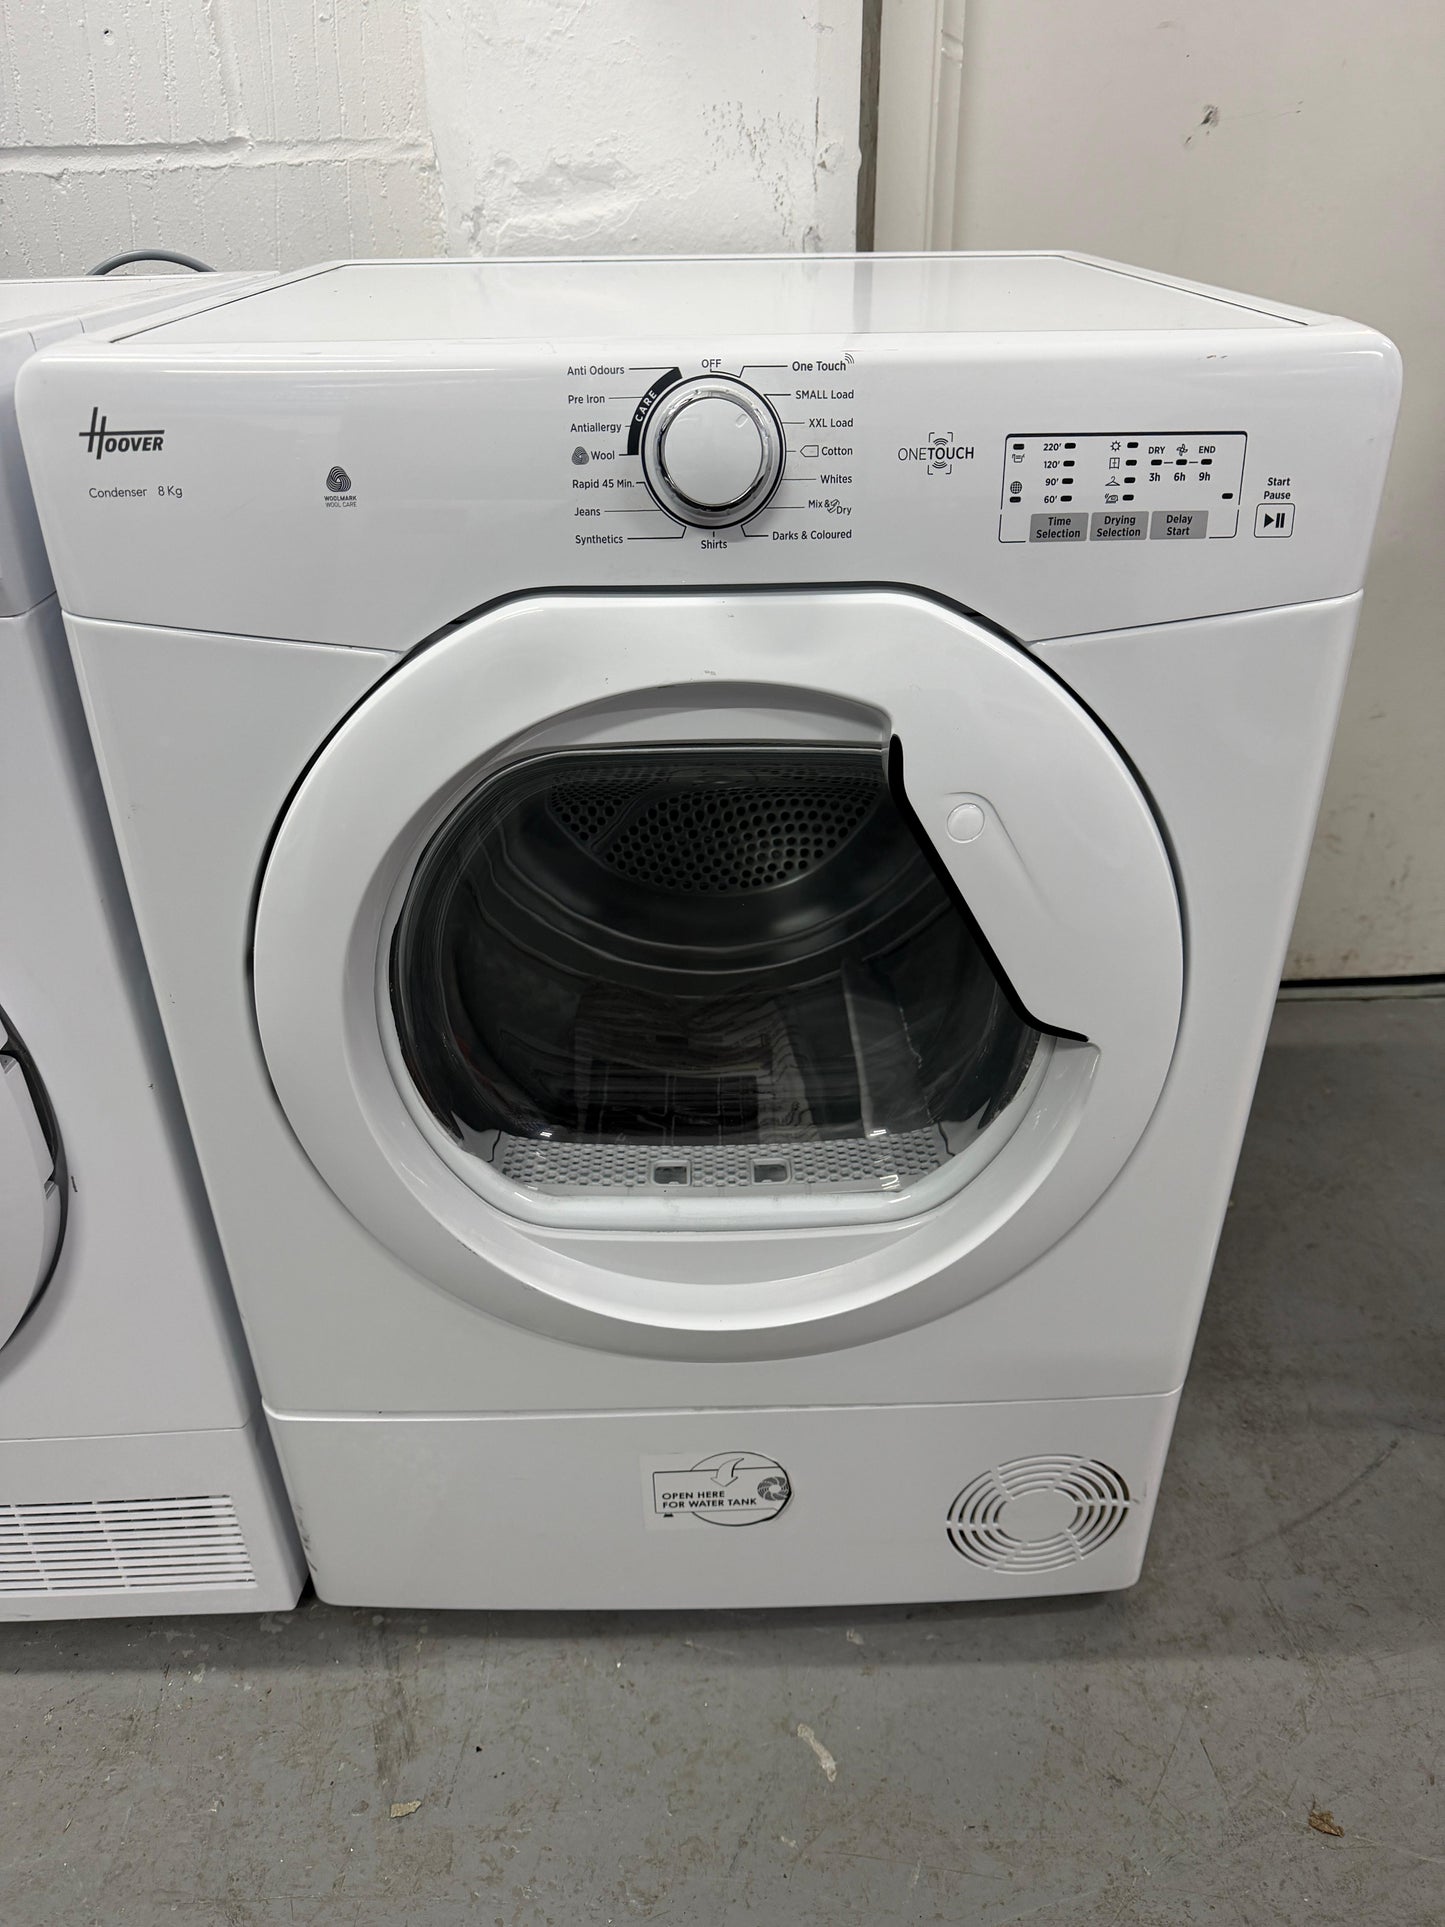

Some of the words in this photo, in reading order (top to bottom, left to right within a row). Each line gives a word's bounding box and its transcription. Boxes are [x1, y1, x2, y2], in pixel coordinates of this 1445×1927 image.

[701, 359, 722, 368] OFF
[792, 361, 815, 372] One
[817, 361, 847, 371] Touch
[567, 366, 587, 376] Anti
[589, 365, 625, 375] Odours
[568, 394, 584, 404] Pre
[586, 394, 605, 404] Iron
[795, 390, 829, 400] SMALL
[831, 390, 854, 400] Load
[635, 389, 657, 423] CARE
[808, 418, 828, 427] XXL
[830, 418, 854, 427] Load
[79, 406, 165, 460] HOOVER
[570, 423, 622, 434] Antiallergy
[821, 446, 853, 456] Cotton
[1148, 446, 1166, 455] DRY
[1198, 445, 1216, 454] END
[591, 451, 615, 461] Wool
[820, 474, 853, 484] Whites
[1149, 472, 1161, 482] 3h
[1173, 472, 1186, 482] 6h
[1198, 472, 1211, 482] 9h
[1267, 476, 1291, 487] Start
[572, 479, 599, 491] Rapid
[602, 479, 614, 488] 45
[616, 478, 635, 488] Min.
[89, 486, 147, 499] Condenser
[1263, 490, 1291, 500] Pause
[574, 507, 601, 517] Jeans
[808, 499, 823, 509] Mix
[836, 505, 852, 516] Dry
[1048, 516, 1072, 526] Time
[1103, 515, 1136, 528] Drying
[1166, 514, 1193, 526] Delay
[772, 531, 799, 541] Darks
[810, 530, 852, 540] Coloured
[1035, 528, 1081, 539] Selection
[1096, 527, 1141, 538] Selection
[1166, 525, 1190, 537] Start
[575, 534, 624, 546] Synthetics
[700, 540, 728, 549] Shirts
[661, 1491, 694, 1501] OPEN
[696, 1490, 726, 1499] HERE
[662, 1501, 686, 1509] FOR
[688, 1499, 726, 1508] WATER
[728, 1497, 758, 1506] TANK
